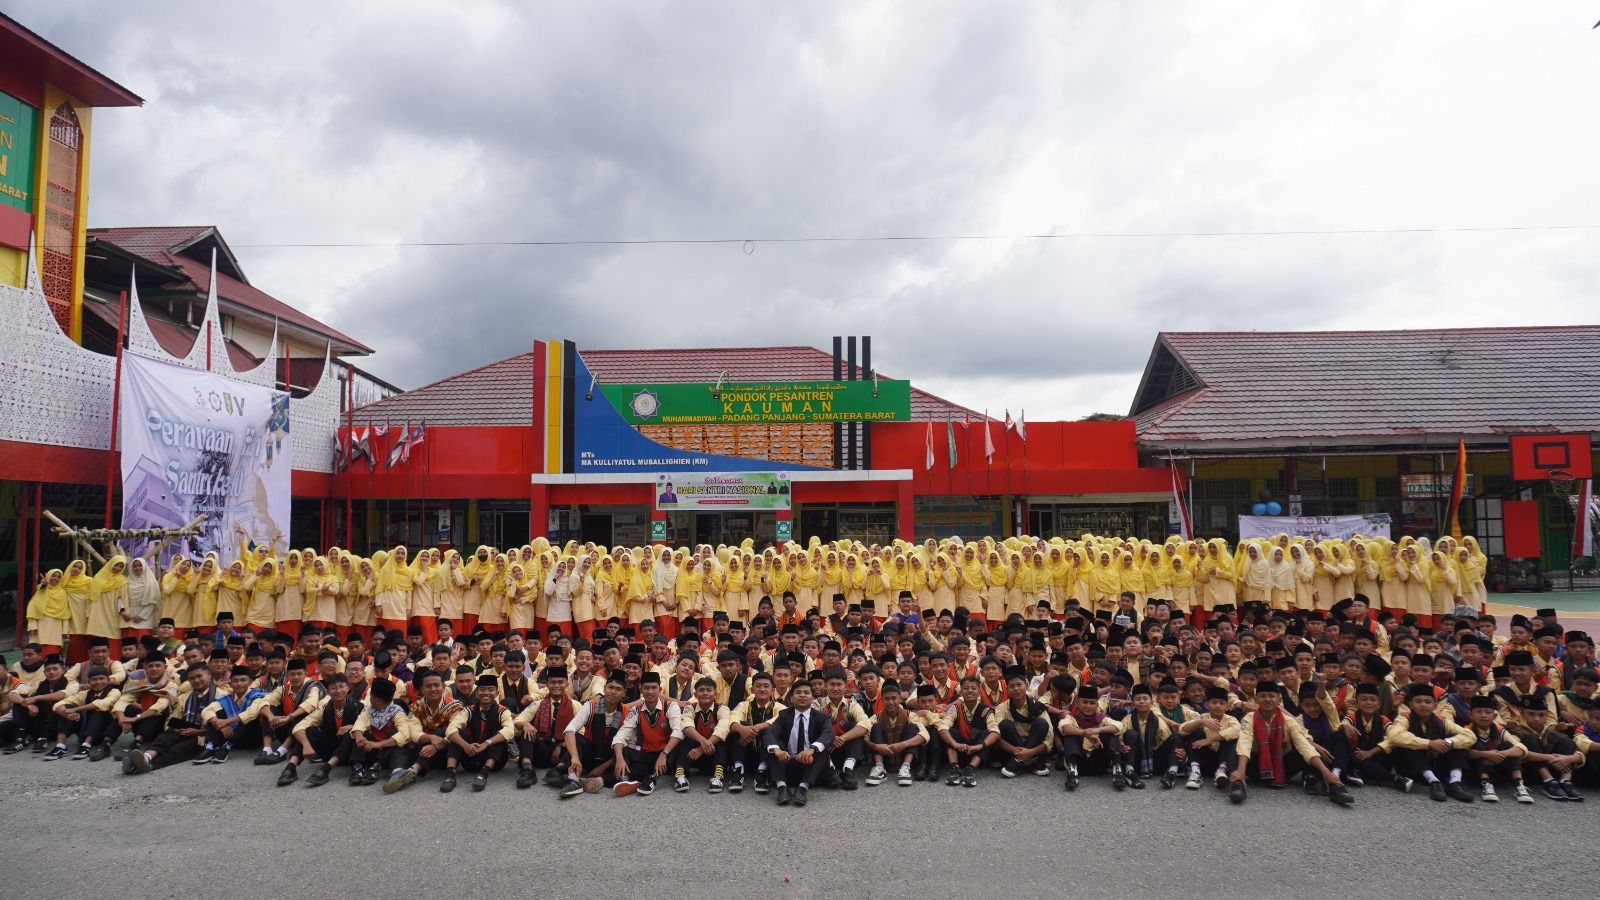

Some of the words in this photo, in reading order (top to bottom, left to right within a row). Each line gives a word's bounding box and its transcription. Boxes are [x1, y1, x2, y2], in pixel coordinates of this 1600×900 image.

[721, 393, 766, 402] PONDOK
[770, 391, 834, 401] PESANTREN
[763, 413, 806, 421] PANJANG
[813, 412, 862, 420] SUMATERA
[865, 412, 896, 420] BARAT
[148, 408, 235, 459] Perayaan
[581, 451, 595, 459] MTs
[593, 458, 636, 466] KULLIYATUL
[638, 458, 691, 466] MUBALLIGHIEN
[692, 457, 709, 466] (KM)
[677, 486, 697, 495] HARI
[697, 486, 726, 495] SANTRI
[726, 485, 767, 495] NASIONAL
